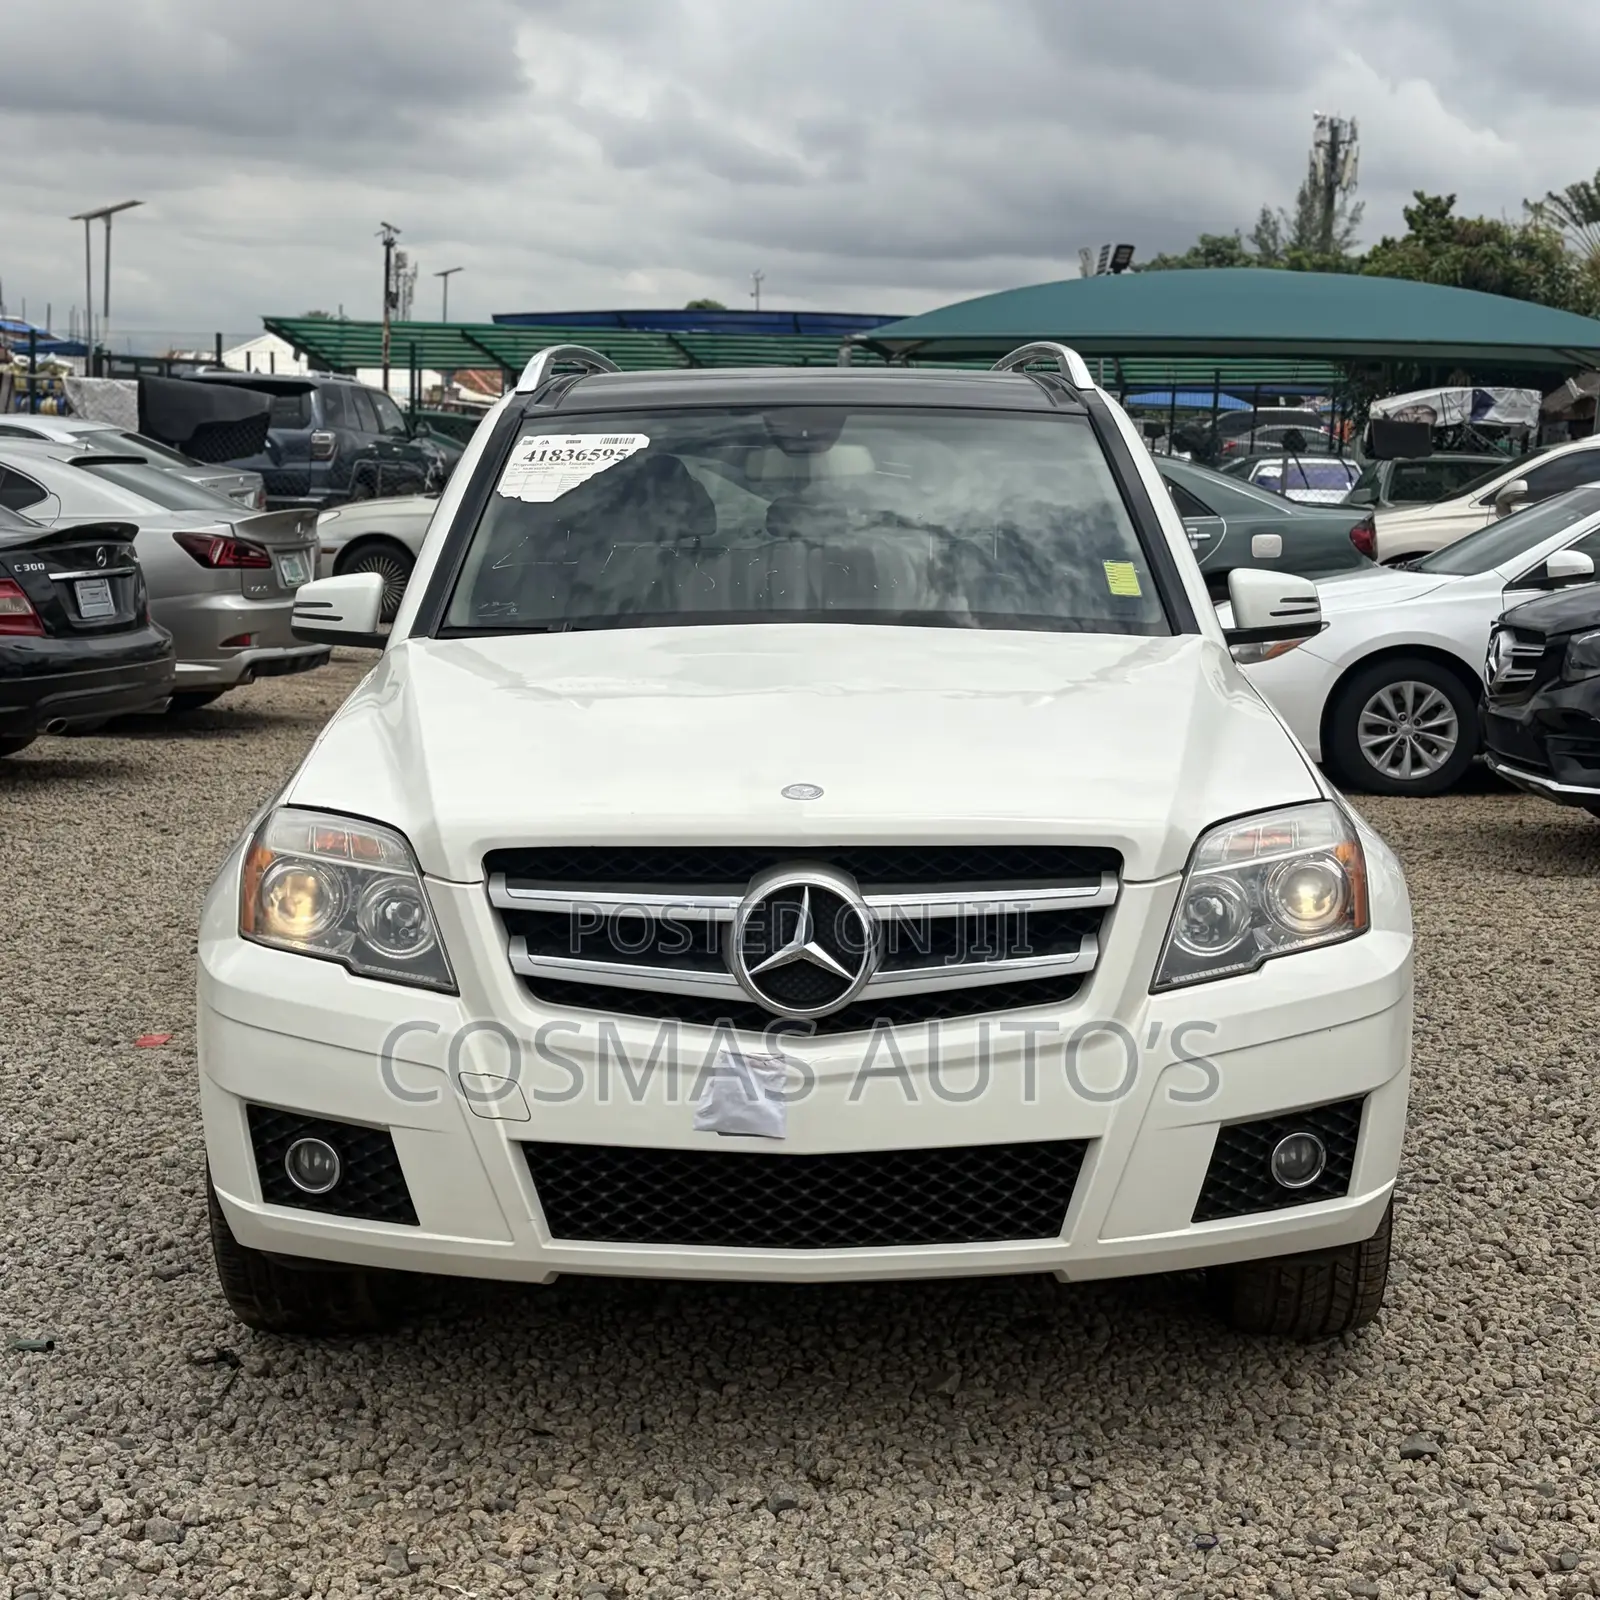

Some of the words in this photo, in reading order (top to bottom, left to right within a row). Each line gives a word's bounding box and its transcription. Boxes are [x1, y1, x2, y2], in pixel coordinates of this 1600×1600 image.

[522, 448, 629, 463] 41836595
[14, 564, 22, 573] C
[23, 562, 45, 572] 300
